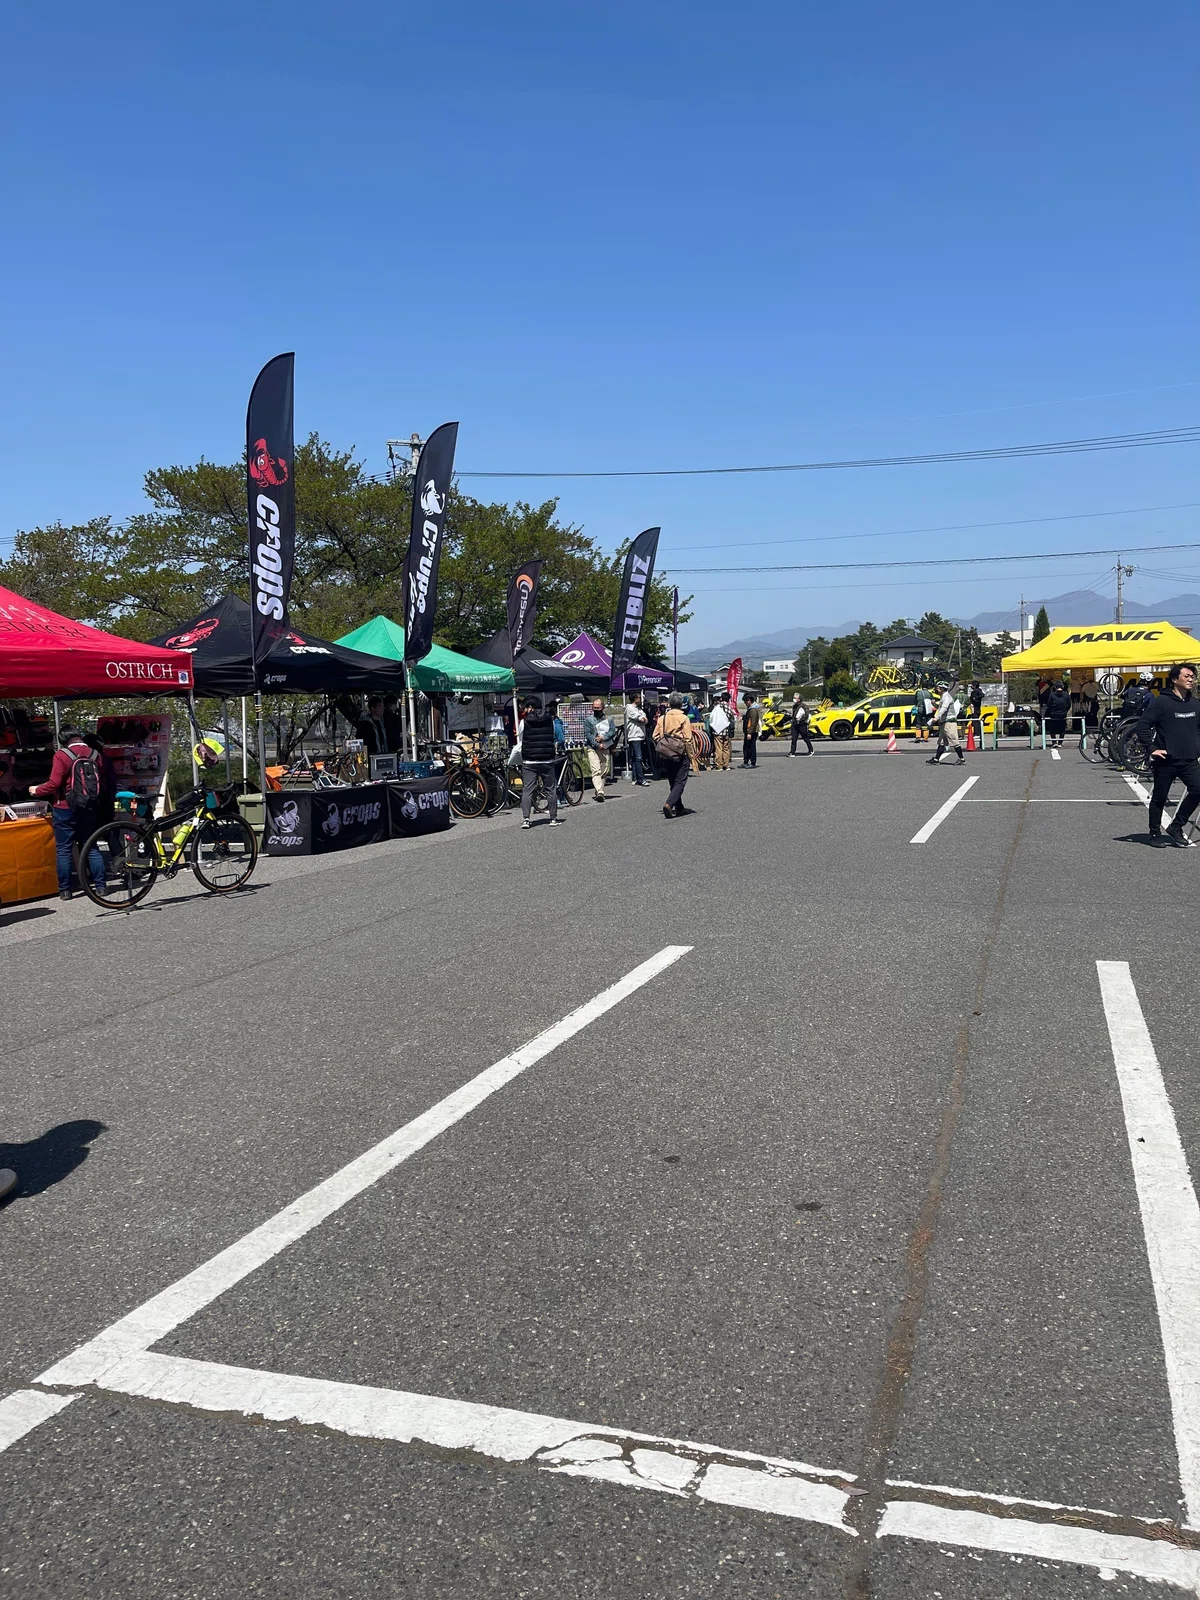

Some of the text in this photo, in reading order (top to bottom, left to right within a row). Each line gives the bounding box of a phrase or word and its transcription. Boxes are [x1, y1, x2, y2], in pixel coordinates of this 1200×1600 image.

[1061, 630, 1163, 645] MAVIC
[105, 661, 174, 680] OSTRICH
[270, 674, 287, 683] crops
[342, 801, 381, 826] crops
[267, 835, 304, 847] crops
